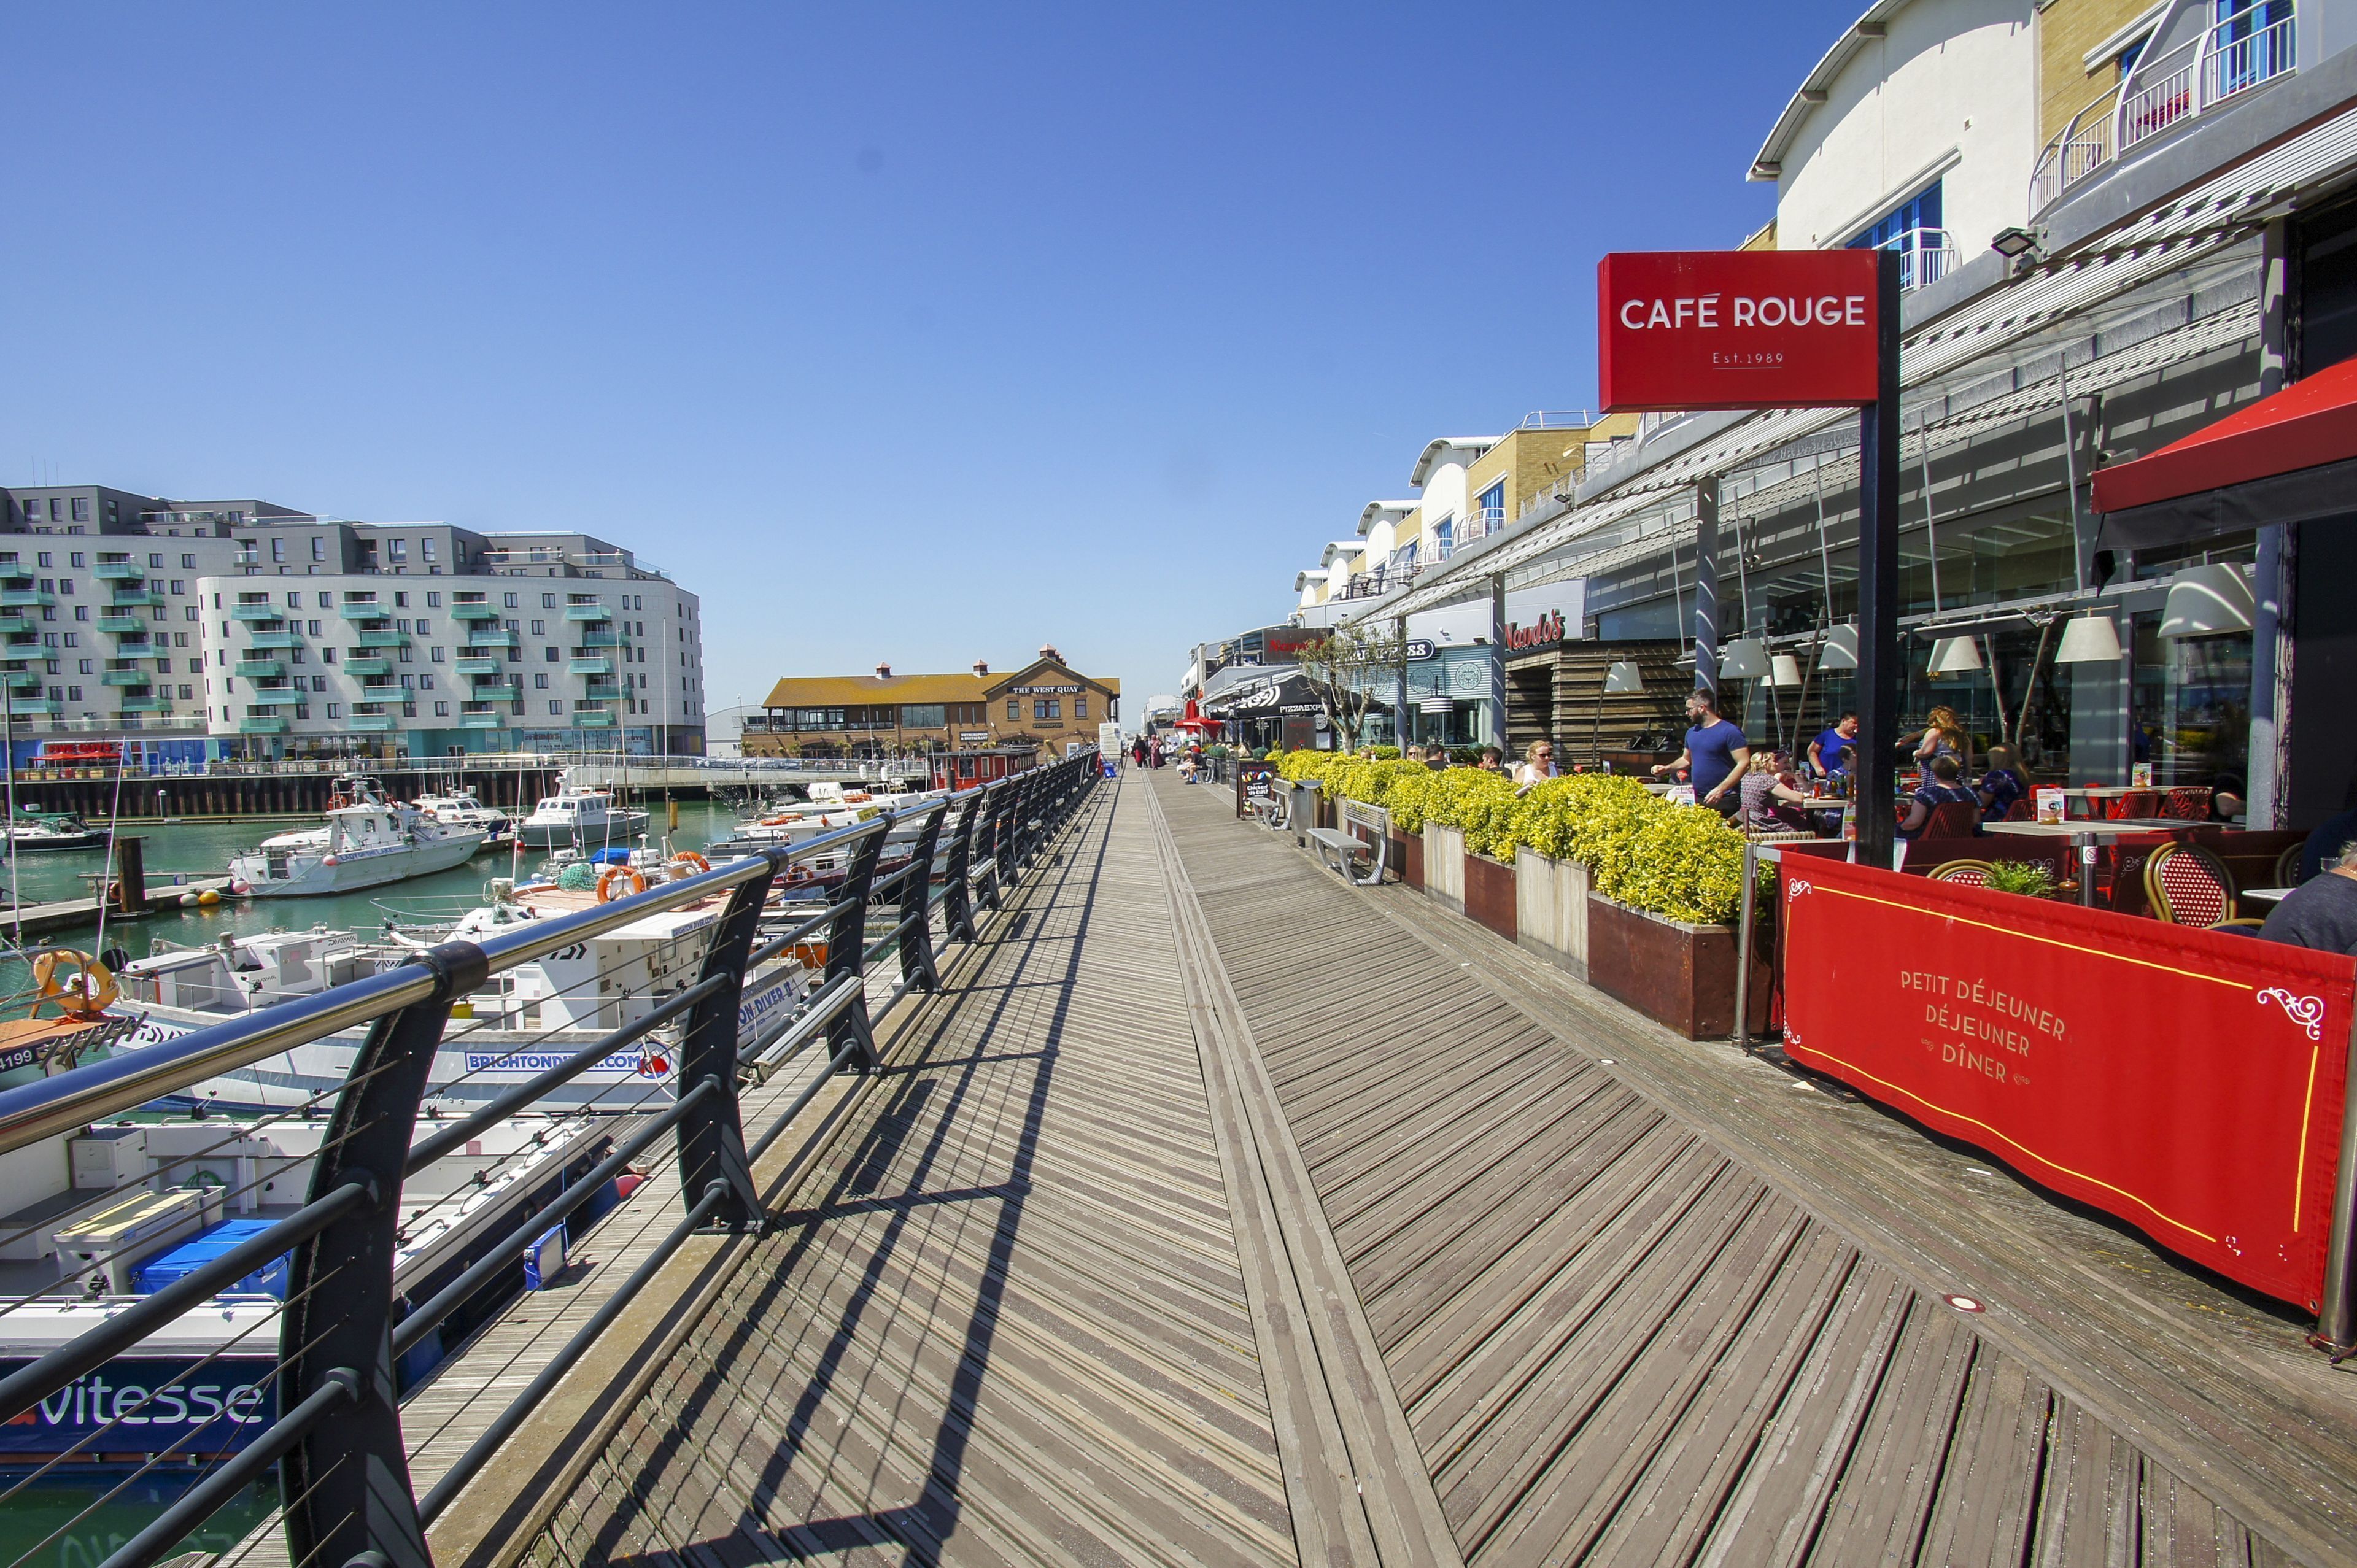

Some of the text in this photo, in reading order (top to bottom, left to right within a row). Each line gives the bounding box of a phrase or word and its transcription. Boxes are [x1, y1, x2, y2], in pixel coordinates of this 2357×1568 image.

[1620, 293, 1865, 330] CAFÉ ROUGE
[1505, 608, 1566, 652] Nando's
[48, 743, 113, 752] FIVE GUYS
[323, 736, 343, 745] Bella
[672, 923, 693, 937] BRIGHTON
[754, 986, 785, 1013] DIVER
[1900, 971, 2065, 1042] PETIT DÉJEUNER
[1925, 1003, 2030, 1057] DÉJEUNER
[1941, 1042, 2007, 1083] DÎNER
[40, 1375, 265, 1424] vitesse
